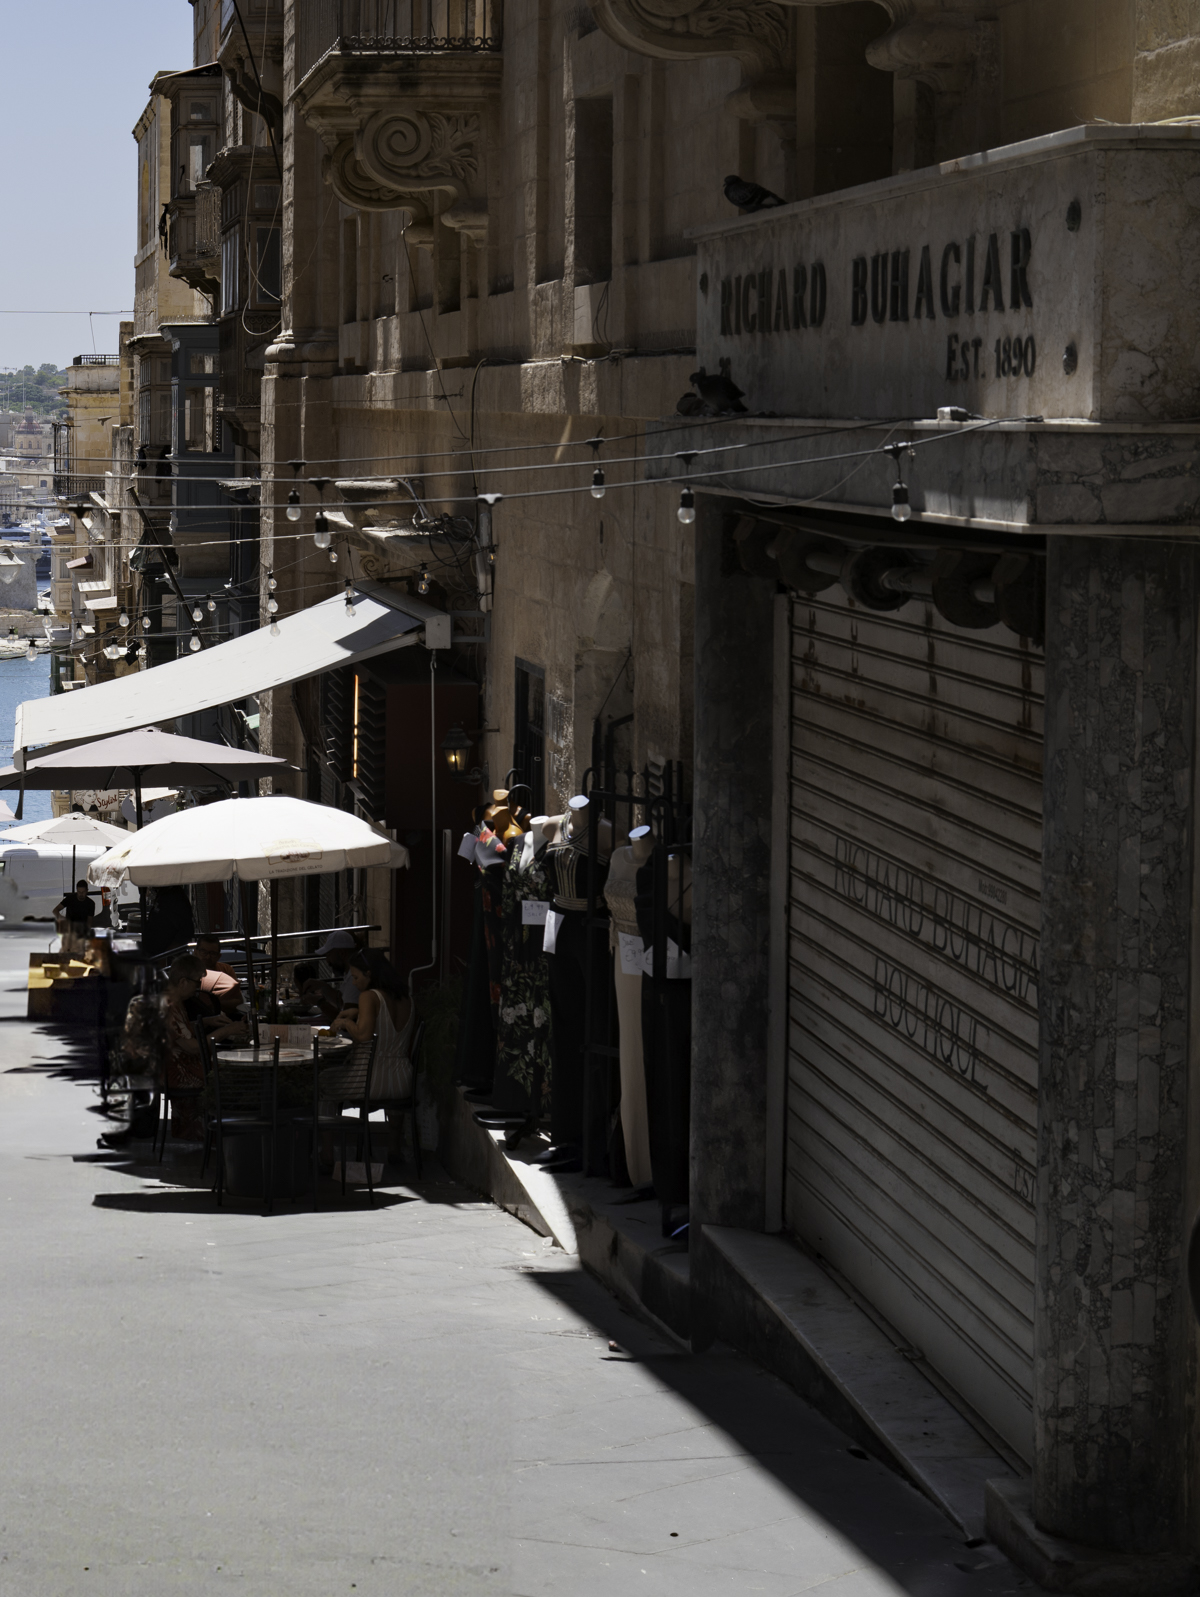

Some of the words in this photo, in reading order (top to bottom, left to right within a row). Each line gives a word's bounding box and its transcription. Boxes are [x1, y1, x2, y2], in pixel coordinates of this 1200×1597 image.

[719, 258, 828, 336] RICHARD
[850, 227, 1034, 327] BUHAGIAR
[993, 333, 1037, 379] 1890
[834, 836, 924, 937] RICHARD
[932, 886, 1040, 1006] BUHAGIA
[873, 956, 990, 1092] BOUTIQUE
